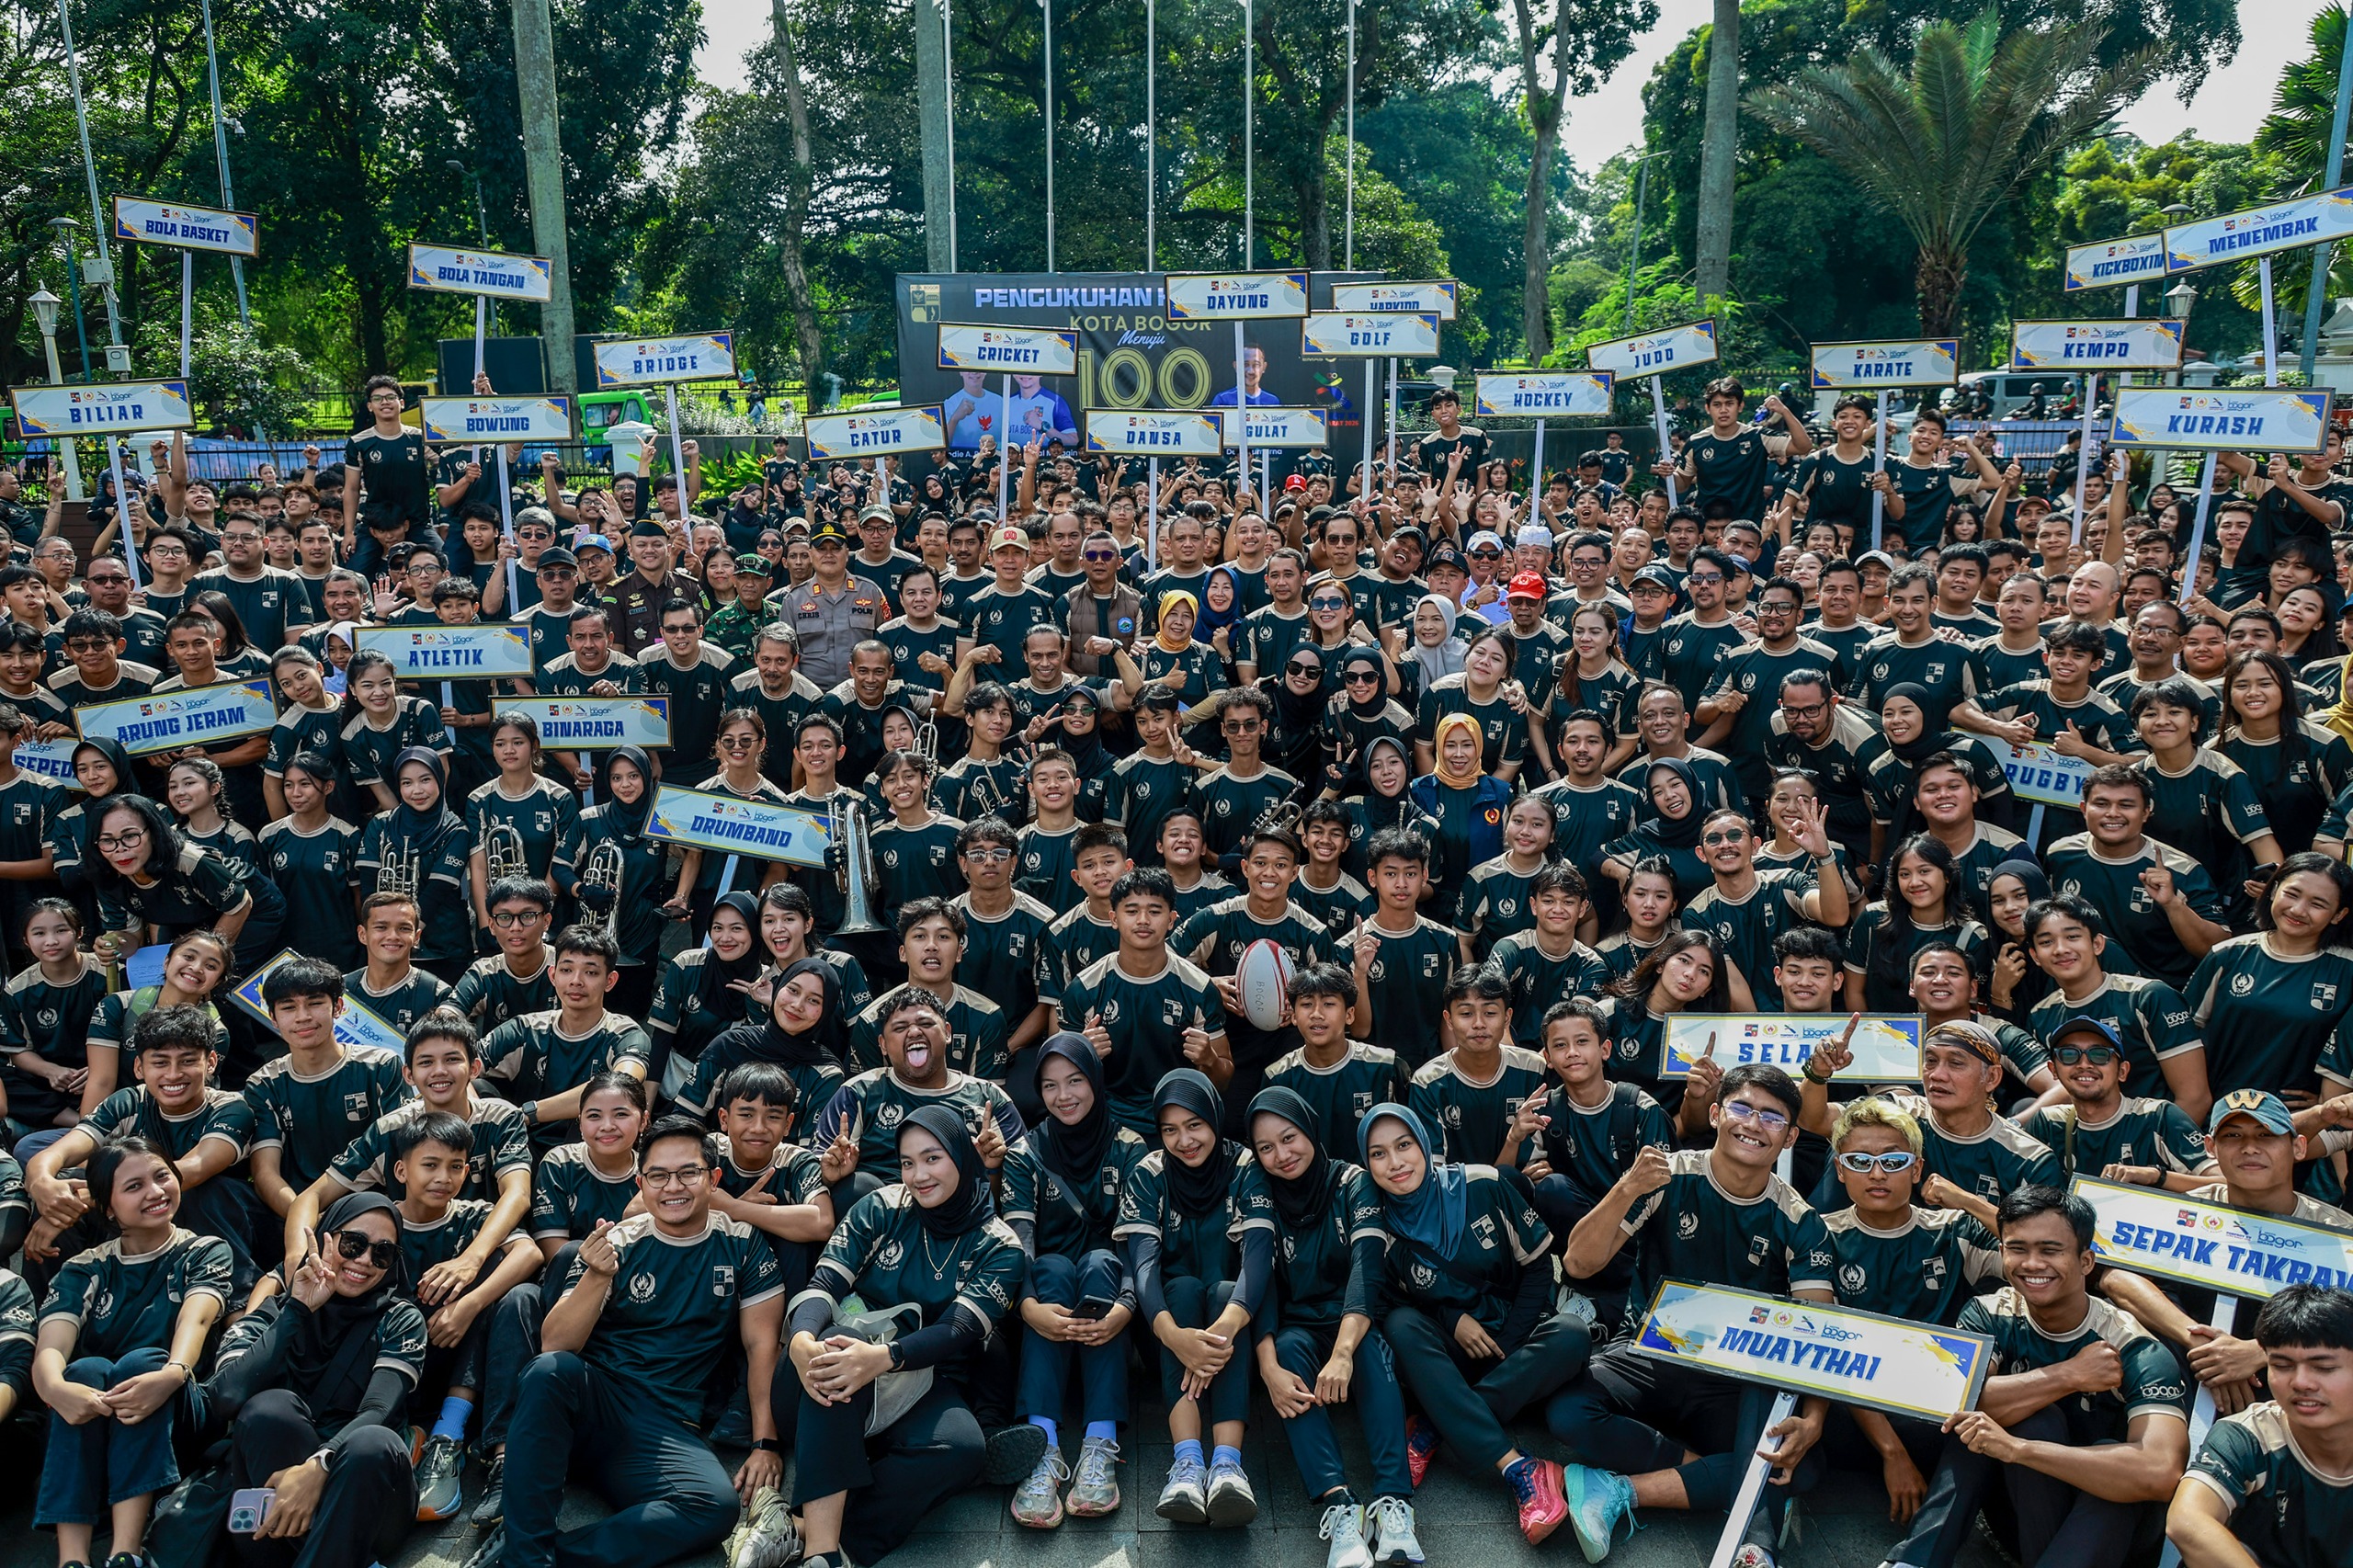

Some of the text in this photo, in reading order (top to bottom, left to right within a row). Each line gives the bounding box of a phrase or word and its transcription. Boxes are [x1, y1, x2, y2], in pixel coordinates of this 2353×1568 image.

[145, 220, 230, 243] BOLA BASKET
[2209, 216, 2320, 254] MENEMBAK
[2092, 254, 2165, 278] KICKBOXIN
[438, 266, 525, 289] BOLA TANGAN
[974, 287, 1152, 308] PENGUKUHAN
[1207, 294, 1268, 310] DAYUNG
[1070, 315, 1128, 331] KOTA
[1117, 329, 1165, 348] Menuju
[1350, 332, 1391, 346] GOLF
[977, 347, 1040, 363] CRICKET
[1633, 347, 1674, 369] JUDO
[2063, 342, 2130, 358] KEMPO
[633, 356, 698, 374] BRIDGE
[1853, 361, 1913, 378] KARATE
[1078, 347, 1211, 411] 100
[1513, 392, 1573, 407] HOCKEY
[69, 404, 143, 423] BILIAR
[466, 416, 529, 432] BOWLING
[1245, 426, 1288, 437] GULAT
[2167, 415, 2264, 436] KURASH
[850, 429, 902, 447] CATUR
[1126, 430, 1182, 446] DANSA
[408, 648, 483, 667] ATLETIK
[117, 706, 246, 744] ARUNG JERAM
[541, 721, 625, 737] BINARAGA
[14, 755, 77, 779] SEPED
[2005, 762, 2087, 796] RUGBY
[691, 815, 792, 848] DRUMBAND
[1256, 981, 1265, 1012] BOGOR
[2112, 1221, 2222, 1268] SEPAK
[2256, 1225, 2303, 1249] bogor
[1822, 1321, 1863, 1342] bogor
[1717, 1326, 1881, 1382] MUAYTHAI
